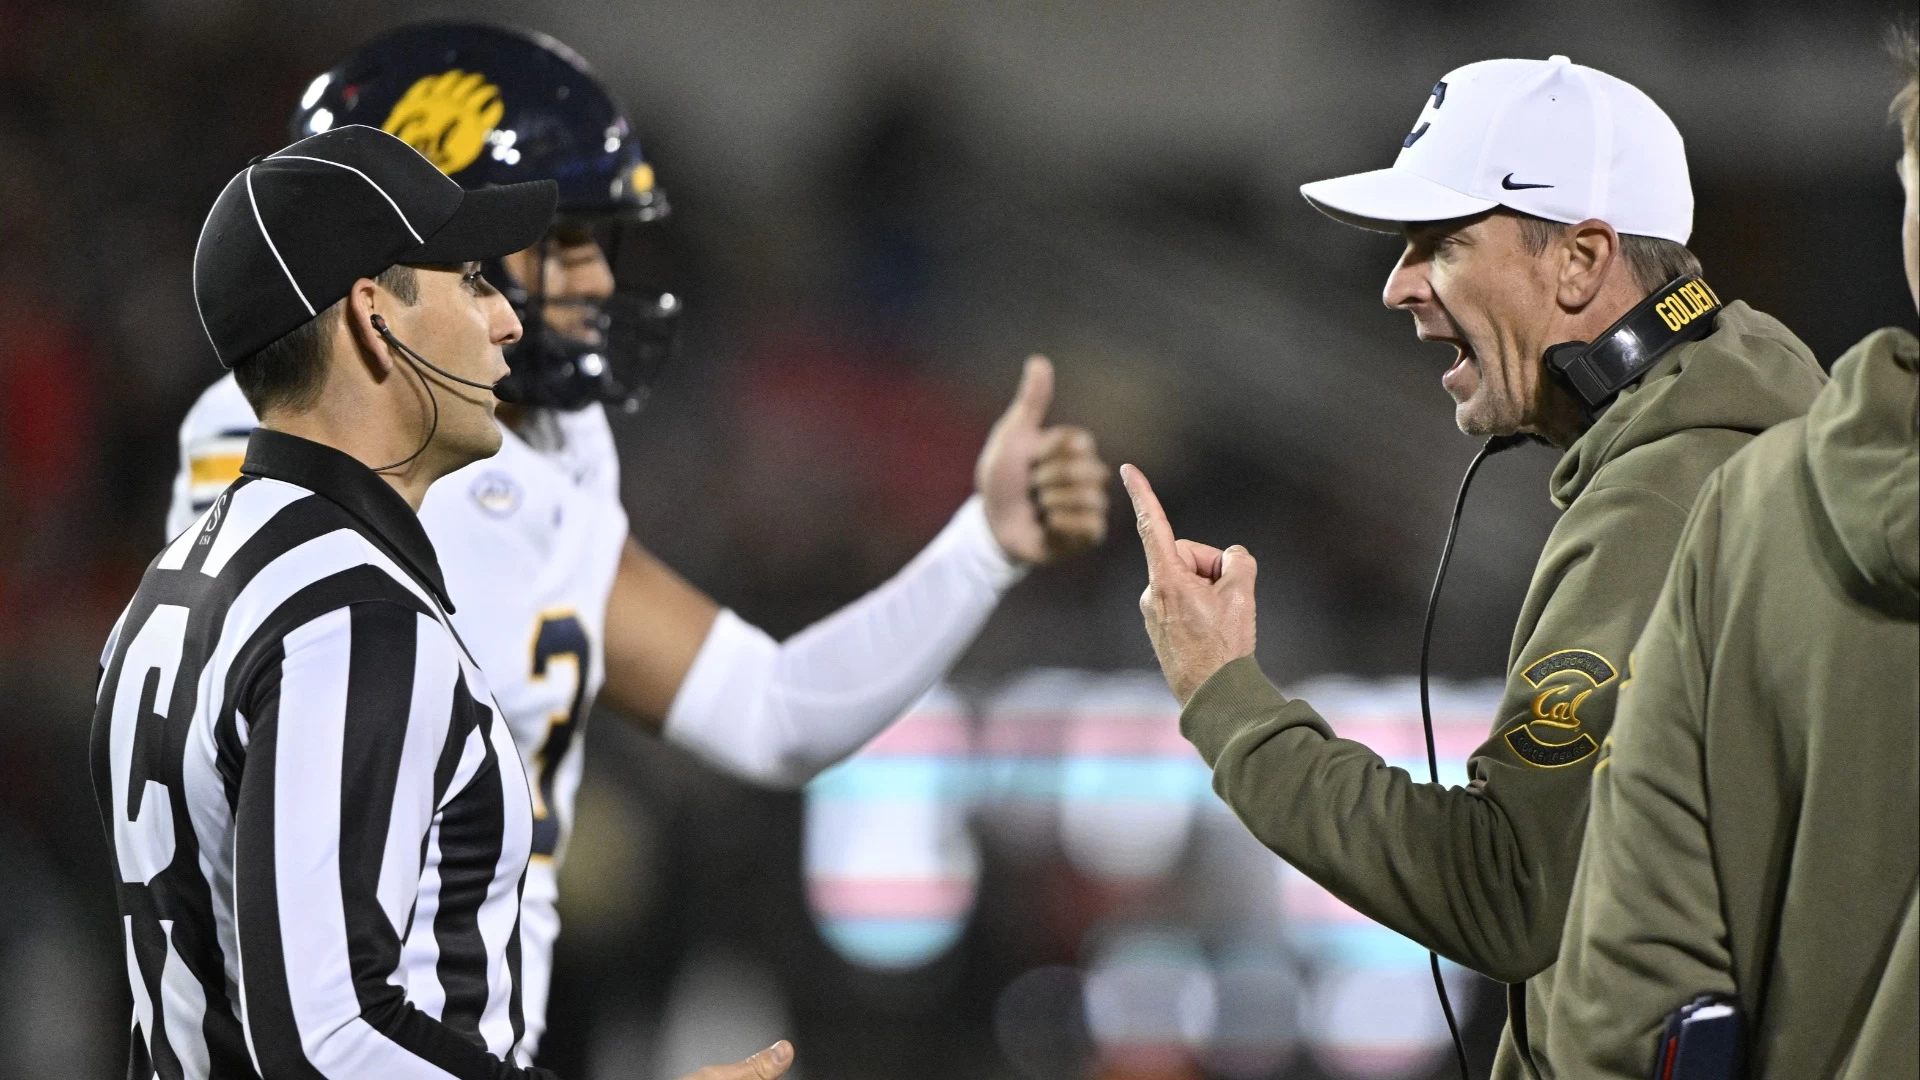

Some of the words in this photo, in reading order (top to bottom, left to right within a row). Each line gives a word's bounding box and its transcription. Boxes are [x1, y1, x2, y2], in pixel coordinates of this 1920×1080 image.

[1540, 656, 1598, 675] CALIFORNIA
[1531, 685, 1592, 728] Cal
[109, 604, 190, 886] C
